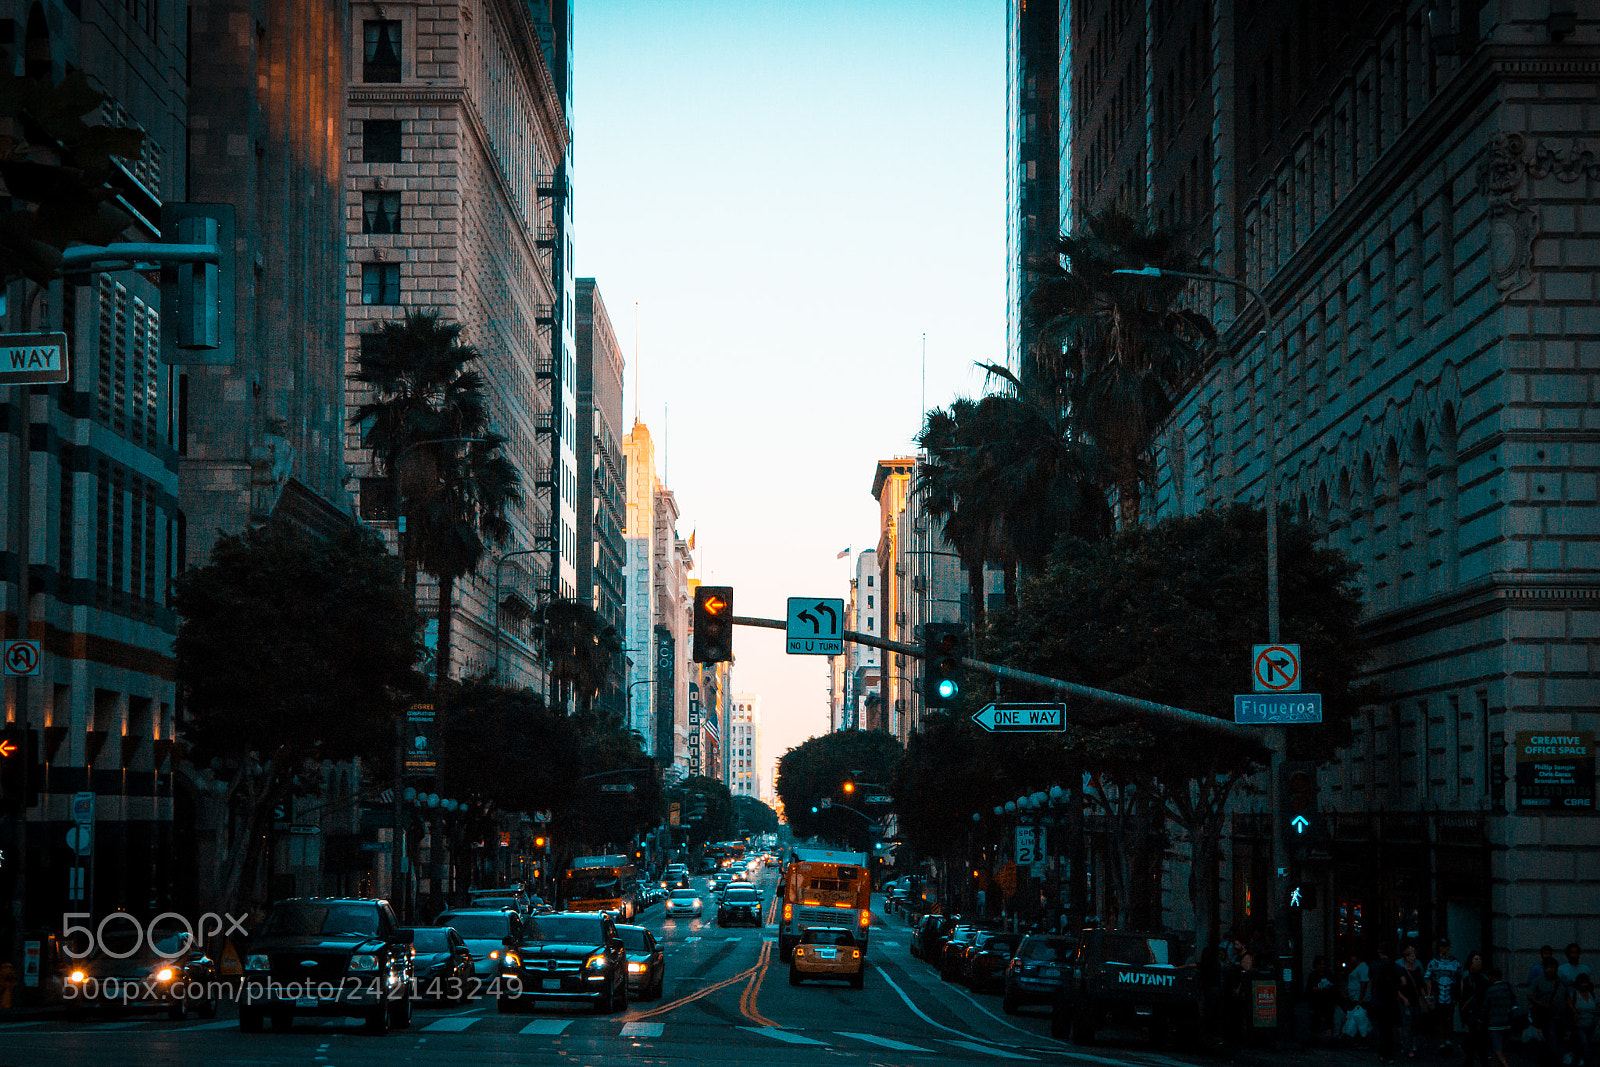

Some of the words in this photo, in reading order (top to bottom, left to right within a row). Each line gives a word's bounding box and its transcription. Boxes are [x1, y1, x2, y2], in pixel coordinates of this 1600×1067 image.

[9, 349, 55, 369] WAY
[790, 641, 801, 650] NO
[805, 641, 814, 652] U
[819, 642, 839, 651] TURN
[1241, 700, 1315, 719] Figueroa
[994, 711, 1020, 724] ONE
[1029, 711, 1057, 724] WAY
[1530, 736, 1581, 745] CREATIVE
[1524, 746, 1557, 755] OFFICE
[1558, 746, 1587, 755] SPACE
[1563, 798, 1592, 806] CBRE
[1118, 971, 1176, 987] MUTANT
